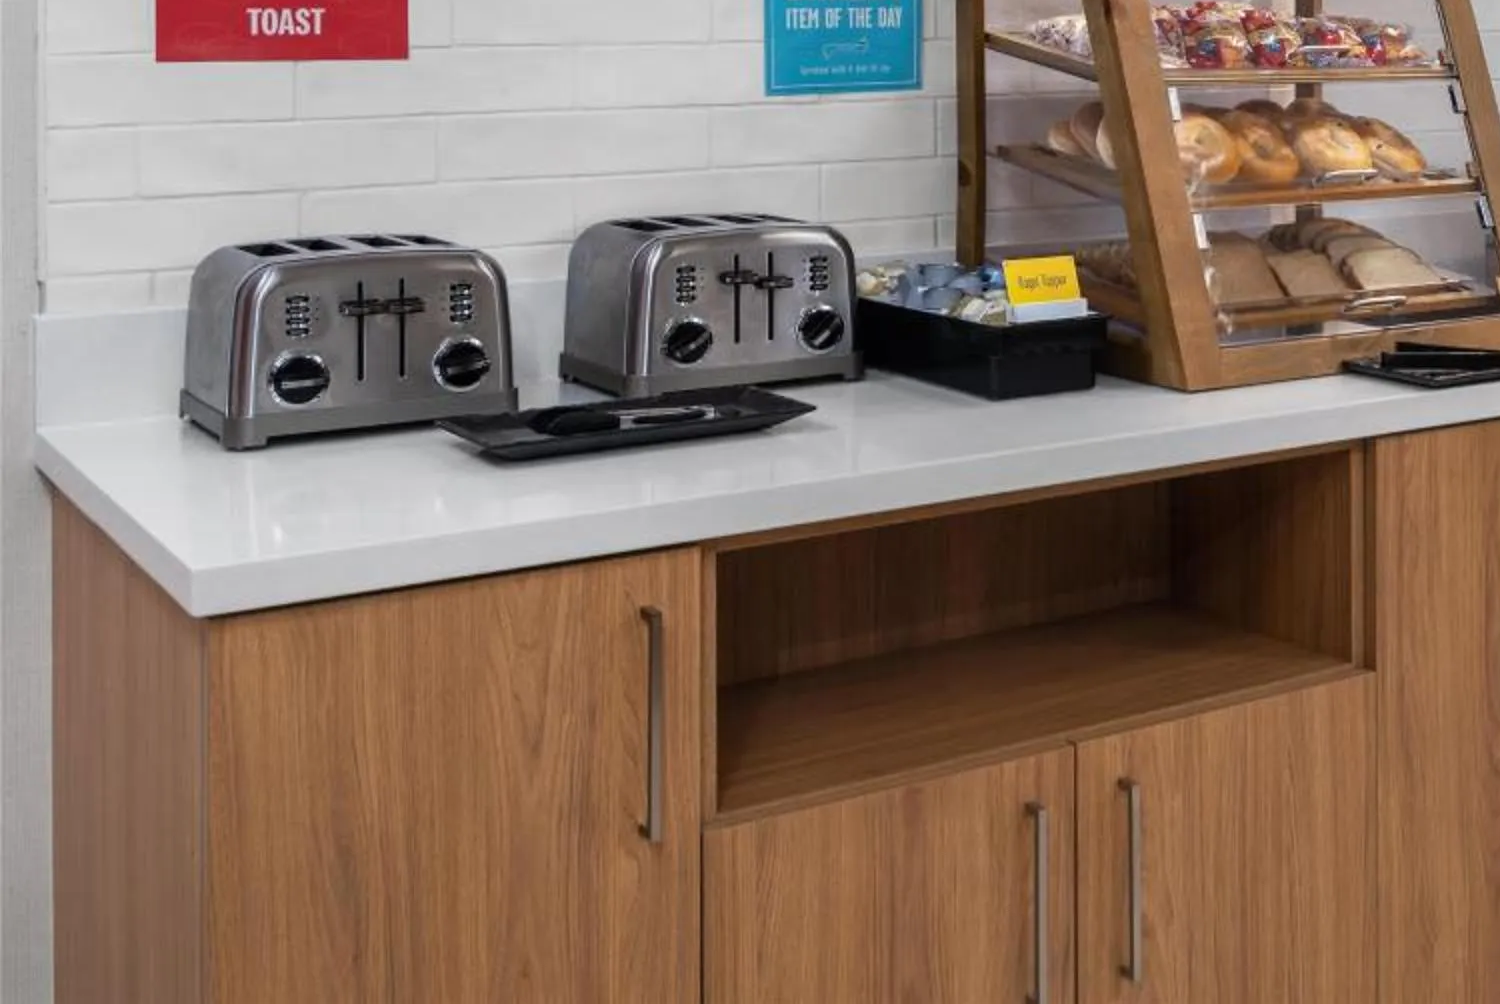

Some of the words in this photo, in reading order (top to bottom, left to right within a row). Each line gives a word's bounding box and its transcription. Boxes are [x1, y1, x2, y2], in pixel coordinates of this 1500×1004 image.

[245, 7, 327, 36] TOAST
[785, 7, 820, 30] ITEM
[825, 7, 842, 29] OF
[848, 7, 873, 29] THE
[877, 7, 903, 29] DAY
